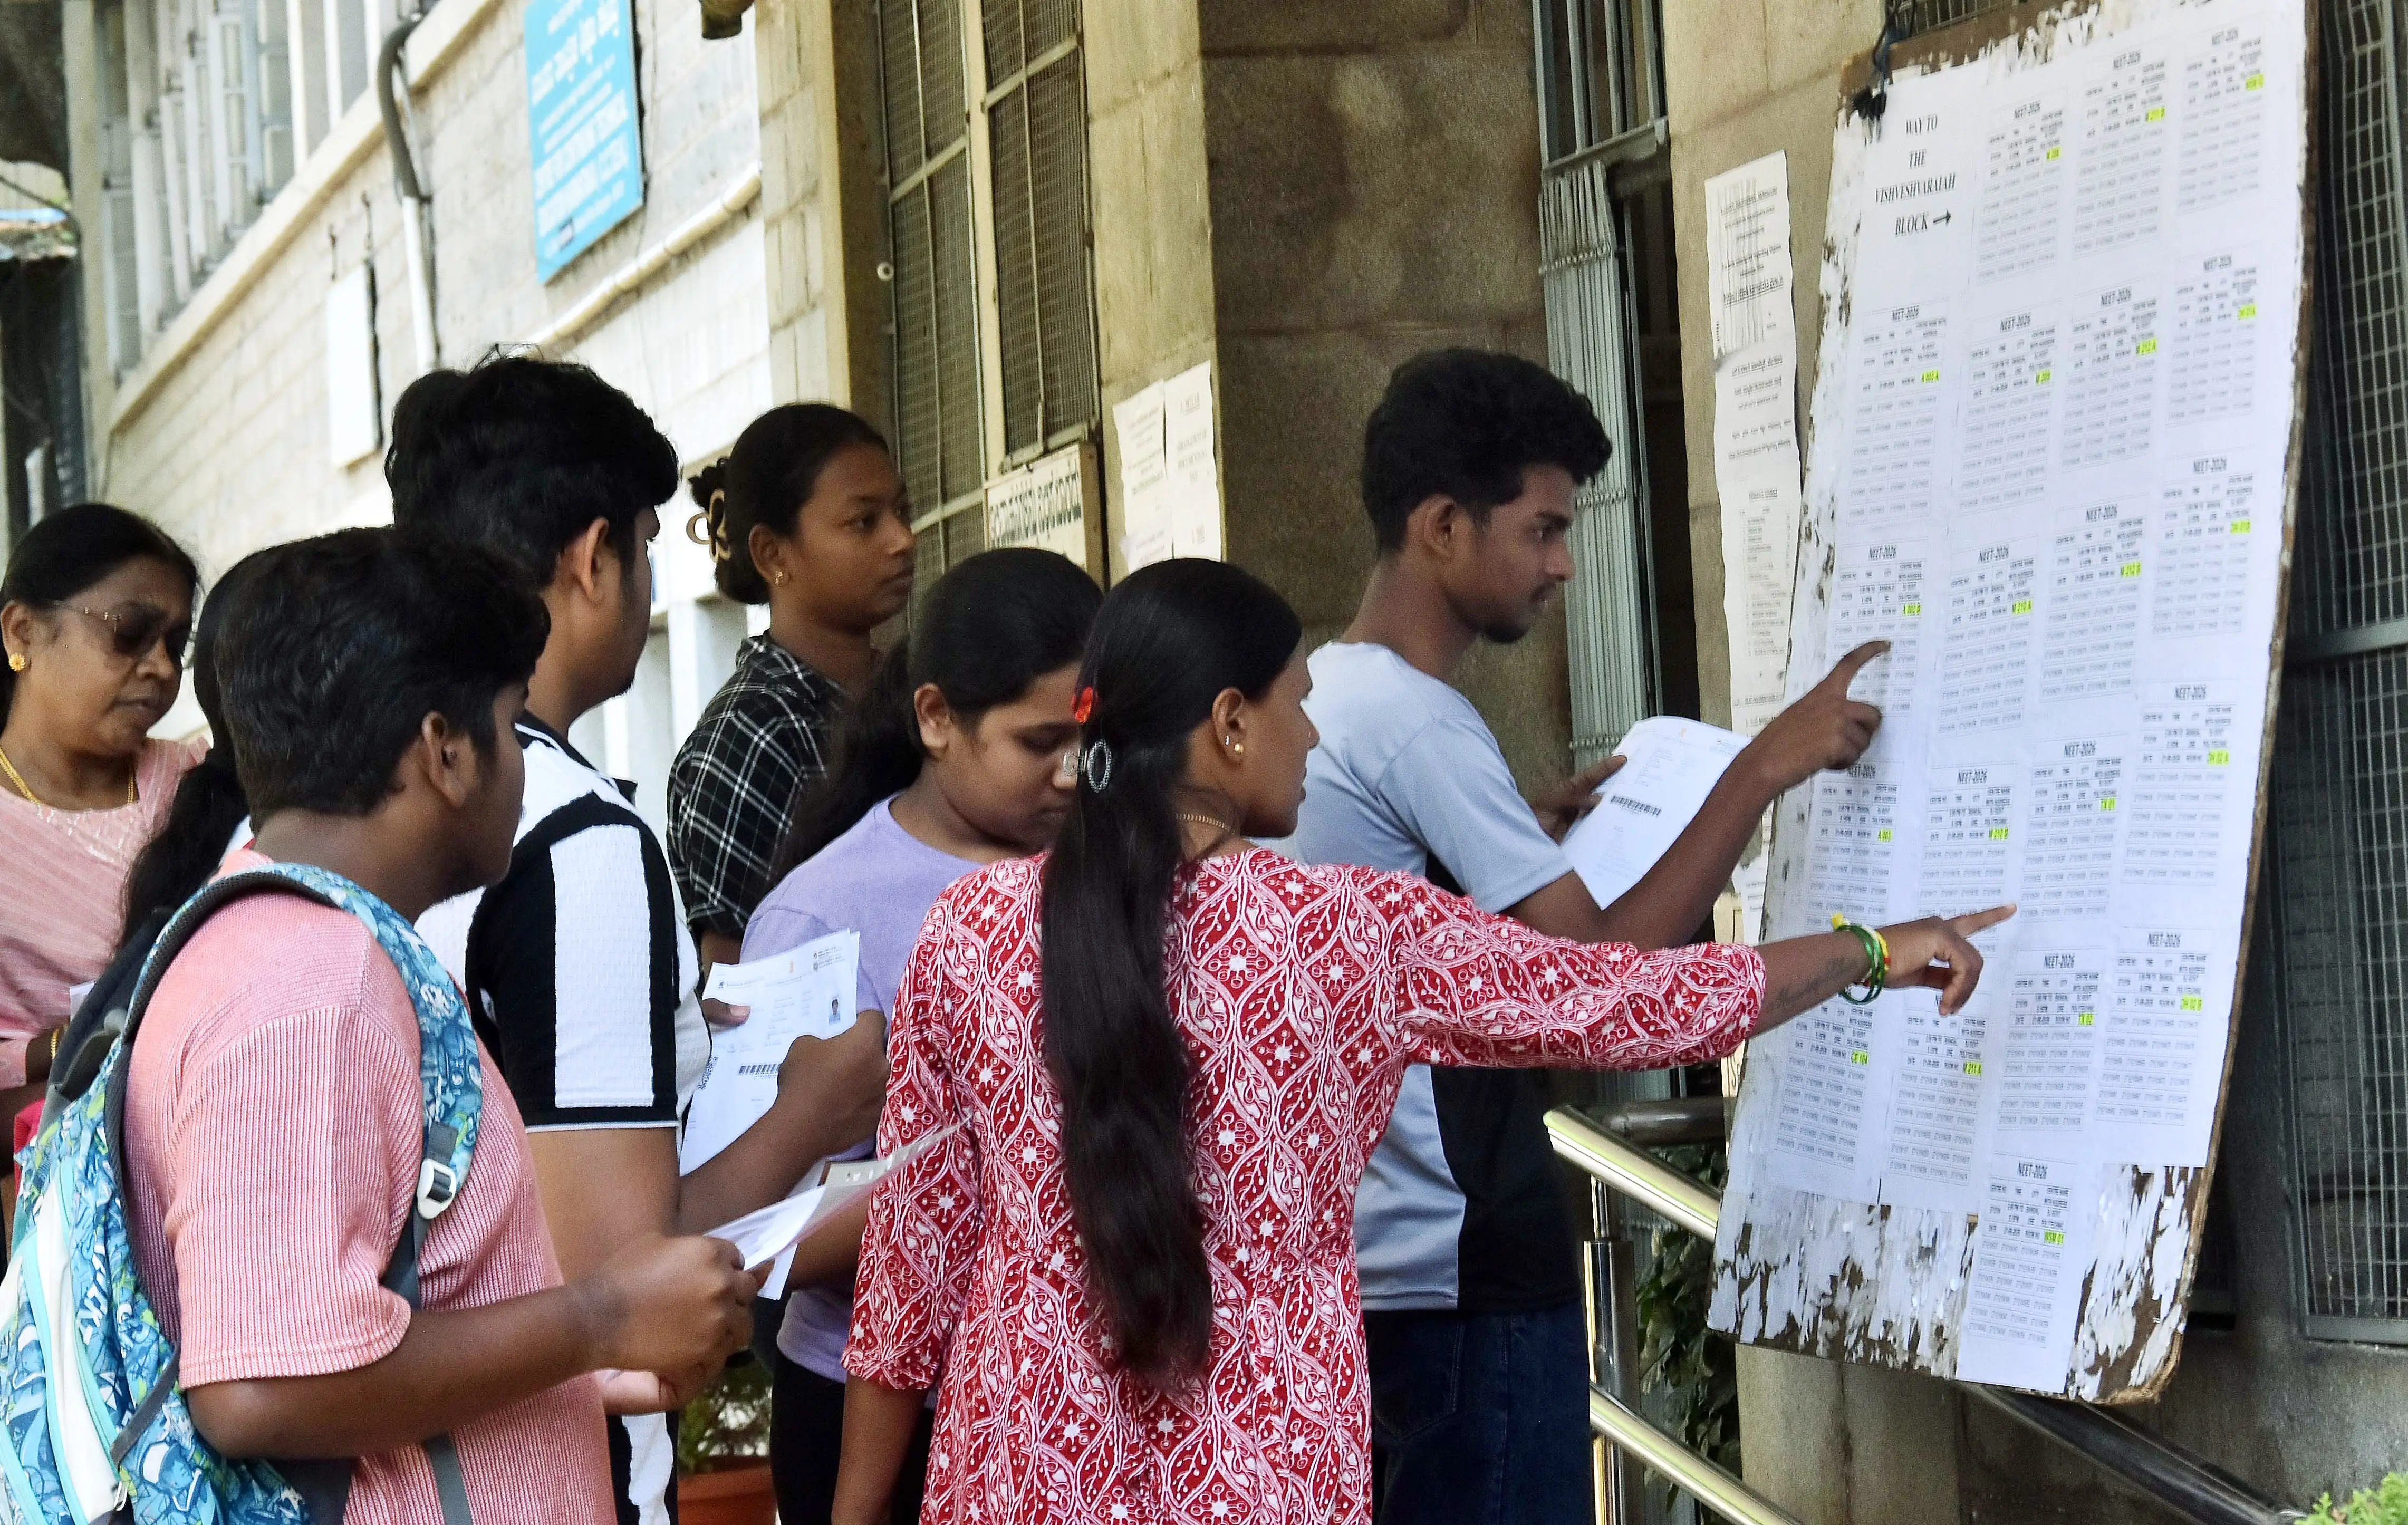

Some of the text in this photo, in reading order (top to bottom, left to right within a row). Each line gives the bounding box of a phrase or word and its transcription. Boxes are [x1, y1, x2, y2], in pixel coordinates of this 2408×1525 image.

[1906, 115, 1938, 134] WAY TO
[1909, 150, 1927, 168] THE
[1895, 211, 1929, 237] BLOCK
[1958, 769, 1987, 785] NEET-2026
[2148, 932, 2181, 948] NEET-2026
[2044, 954, 2075, 969] NEET-2026
[2017, 1161, 2048, 1180] NEET-2026
